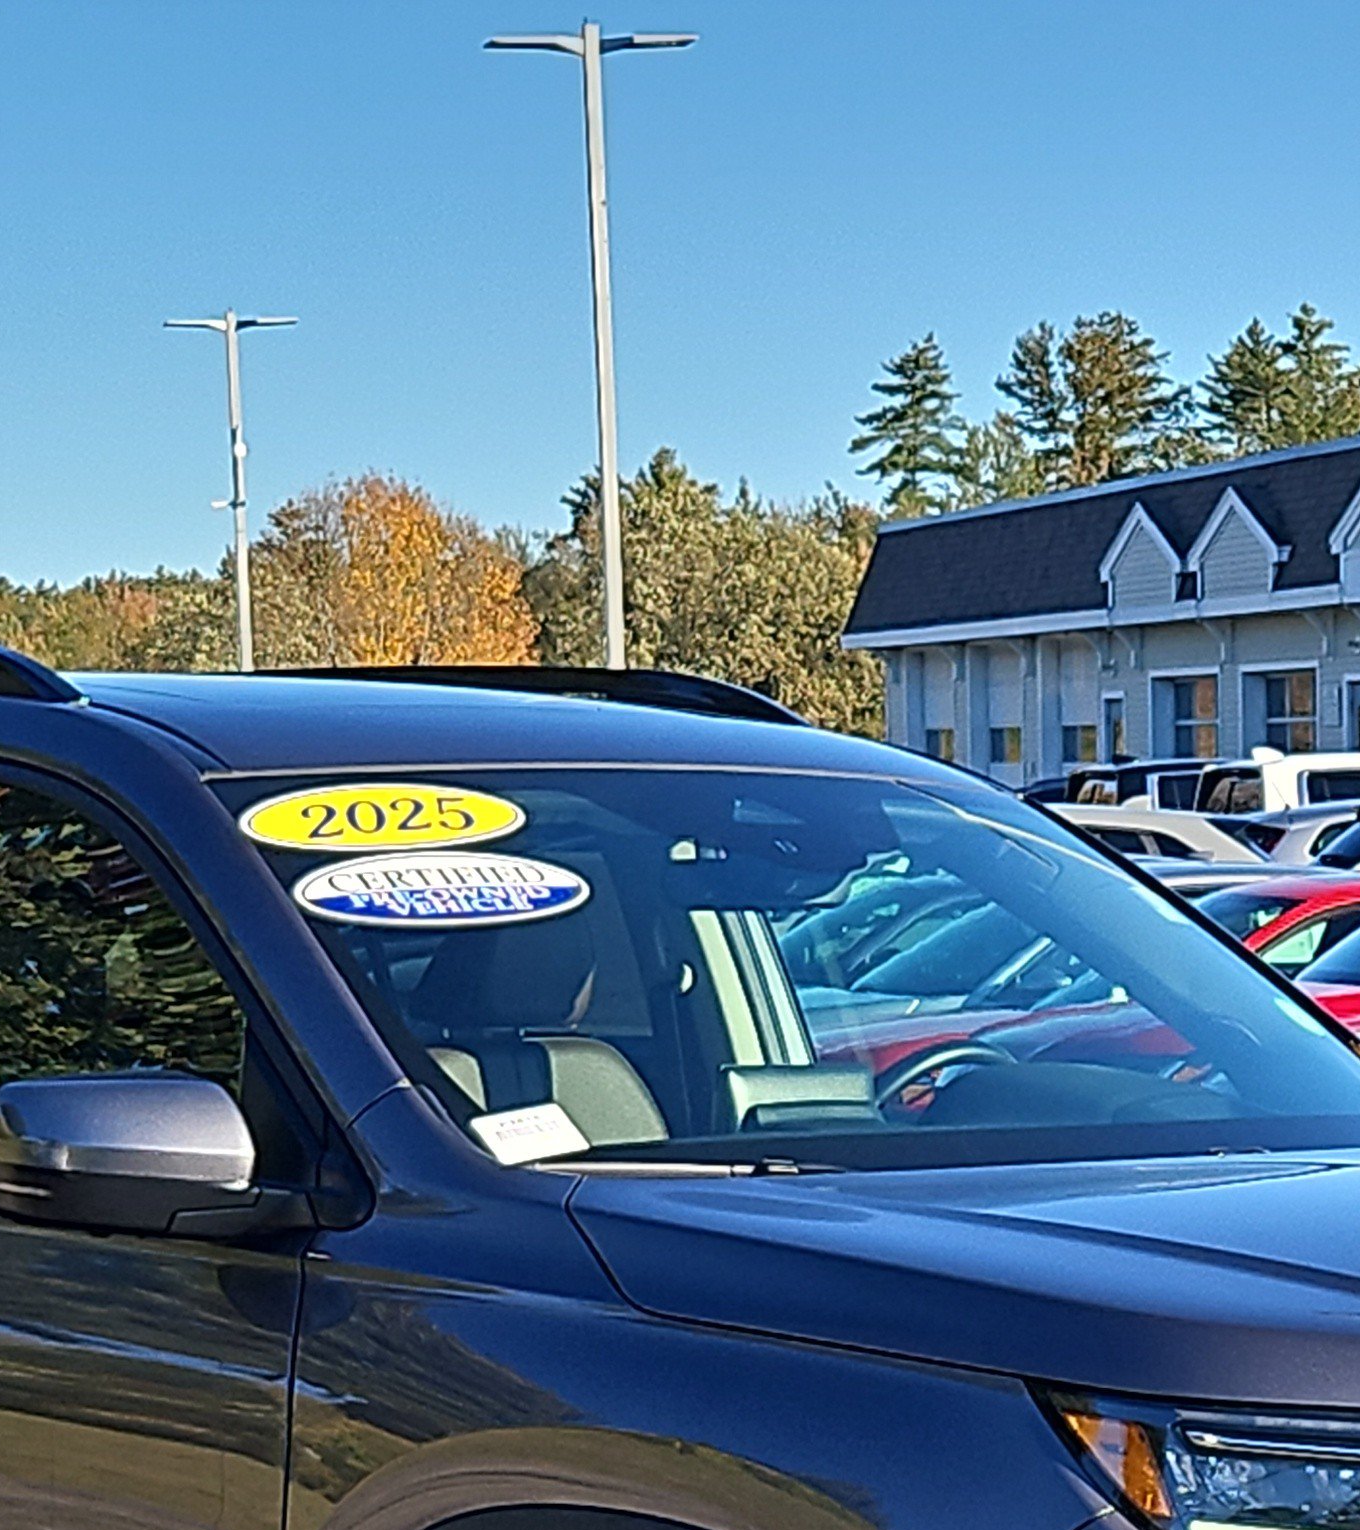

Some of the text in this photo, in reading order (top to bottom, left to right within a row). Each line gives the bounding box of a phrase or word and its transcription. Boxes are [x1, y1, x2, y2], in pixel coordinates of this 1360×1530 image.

[300, 797, 475, 838] 2025
[327, 864, 546, 892] CERTIFIED
[390, 896, 534, 916] VEHICLE
